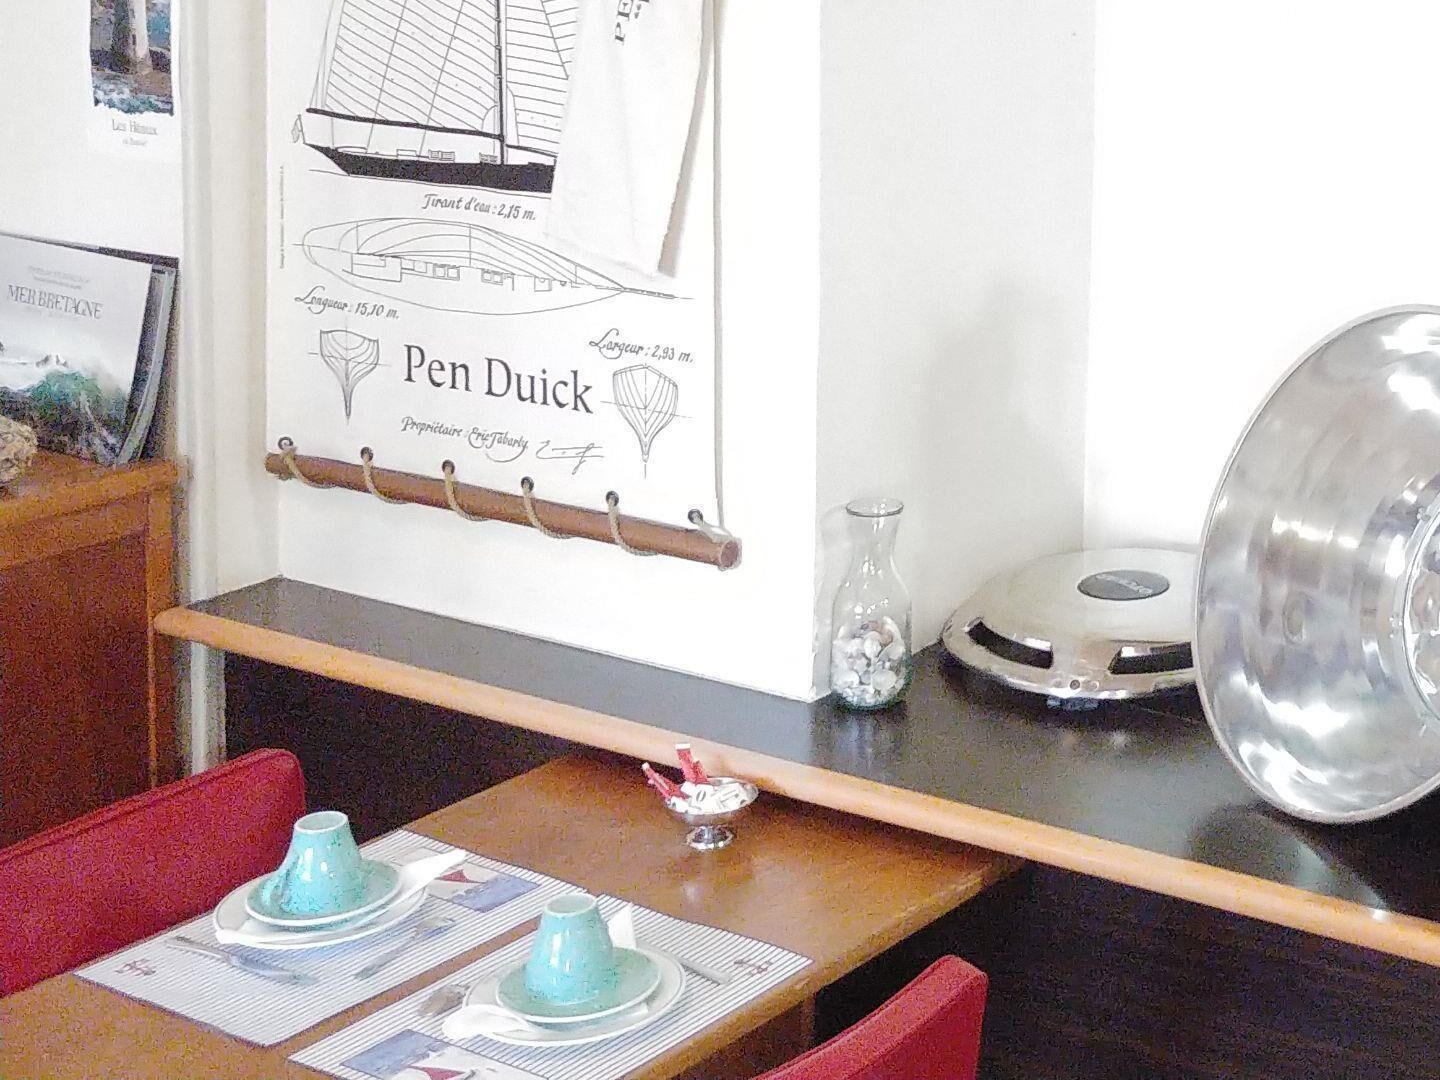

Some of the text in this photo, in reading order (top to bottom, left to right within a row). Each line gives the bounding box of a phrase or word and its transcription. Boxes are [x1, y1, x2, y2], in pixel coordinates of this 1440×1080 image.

[421, 193, 463, 210] Tirant
[497, 202, 522, 220] 2,15
[7, 283, 105, 320] MER BRETAGNE
[354, 301, 385, 318] 15,10
[651, 344, 676, 361] 2,93
[403, 343, 594, 415] Pen Duick
